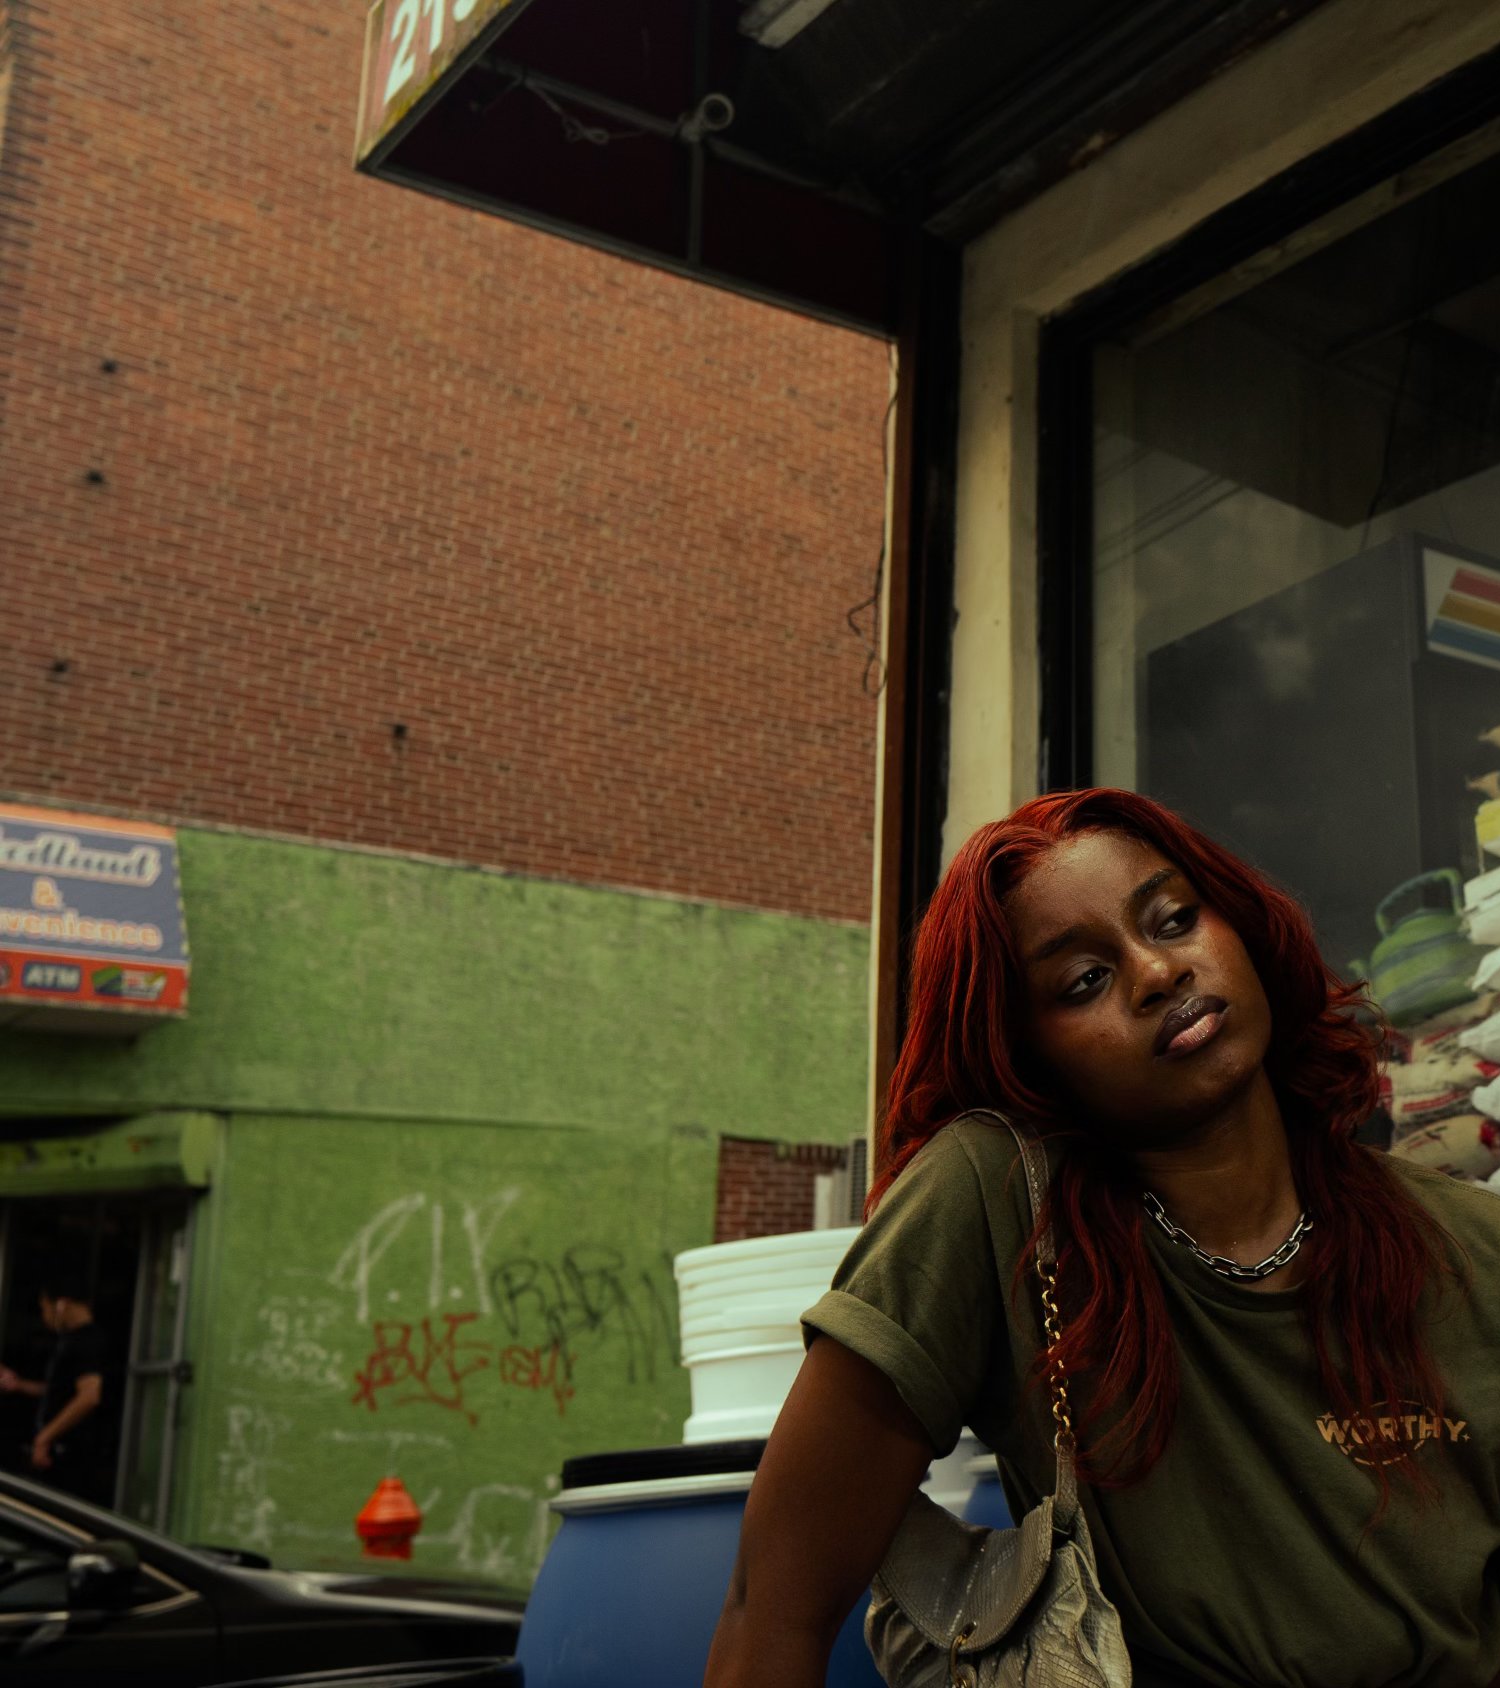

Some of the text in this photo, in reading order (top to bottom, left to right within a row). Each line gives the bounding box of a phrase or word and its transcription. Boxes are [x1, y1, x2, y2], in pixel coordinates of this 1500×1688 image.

[384, 0, 480, 105] 21
[0, 909, 160, 949] venience
[26, 965, 80, 991] ATM
[1315, 1414, 1467, 1445] WORTHY
